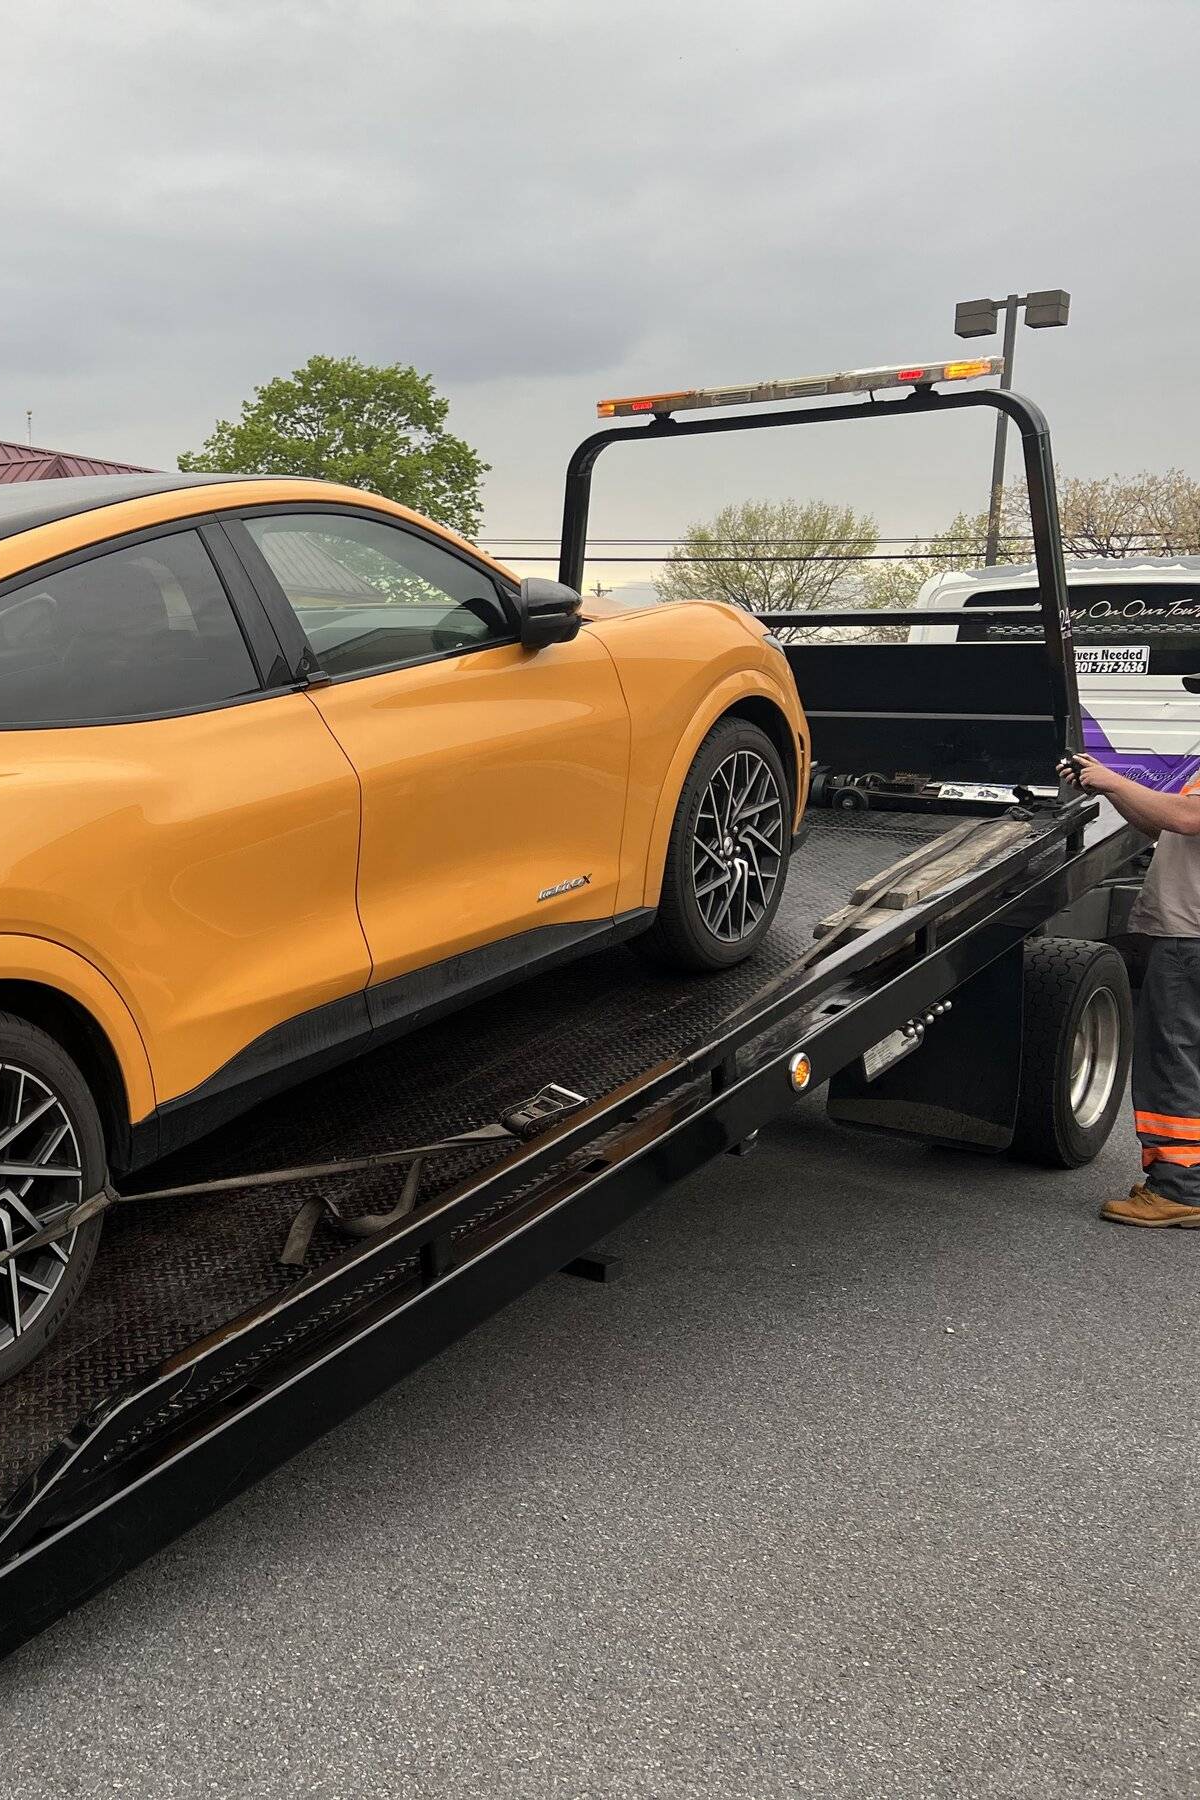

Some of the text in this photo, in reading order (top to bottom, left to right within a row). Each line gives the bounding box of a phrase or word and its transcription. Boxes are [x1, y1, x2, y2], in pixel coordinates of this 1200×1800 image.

[1089, 600, 1121, 618] On
[1122, 599, 1167, 618] Our
[1059, 607, 1071, 631] 24
[1073, 649, 1143, 660] ivers Needed
[1074, 661, 1144, 673] 301-737-2636
